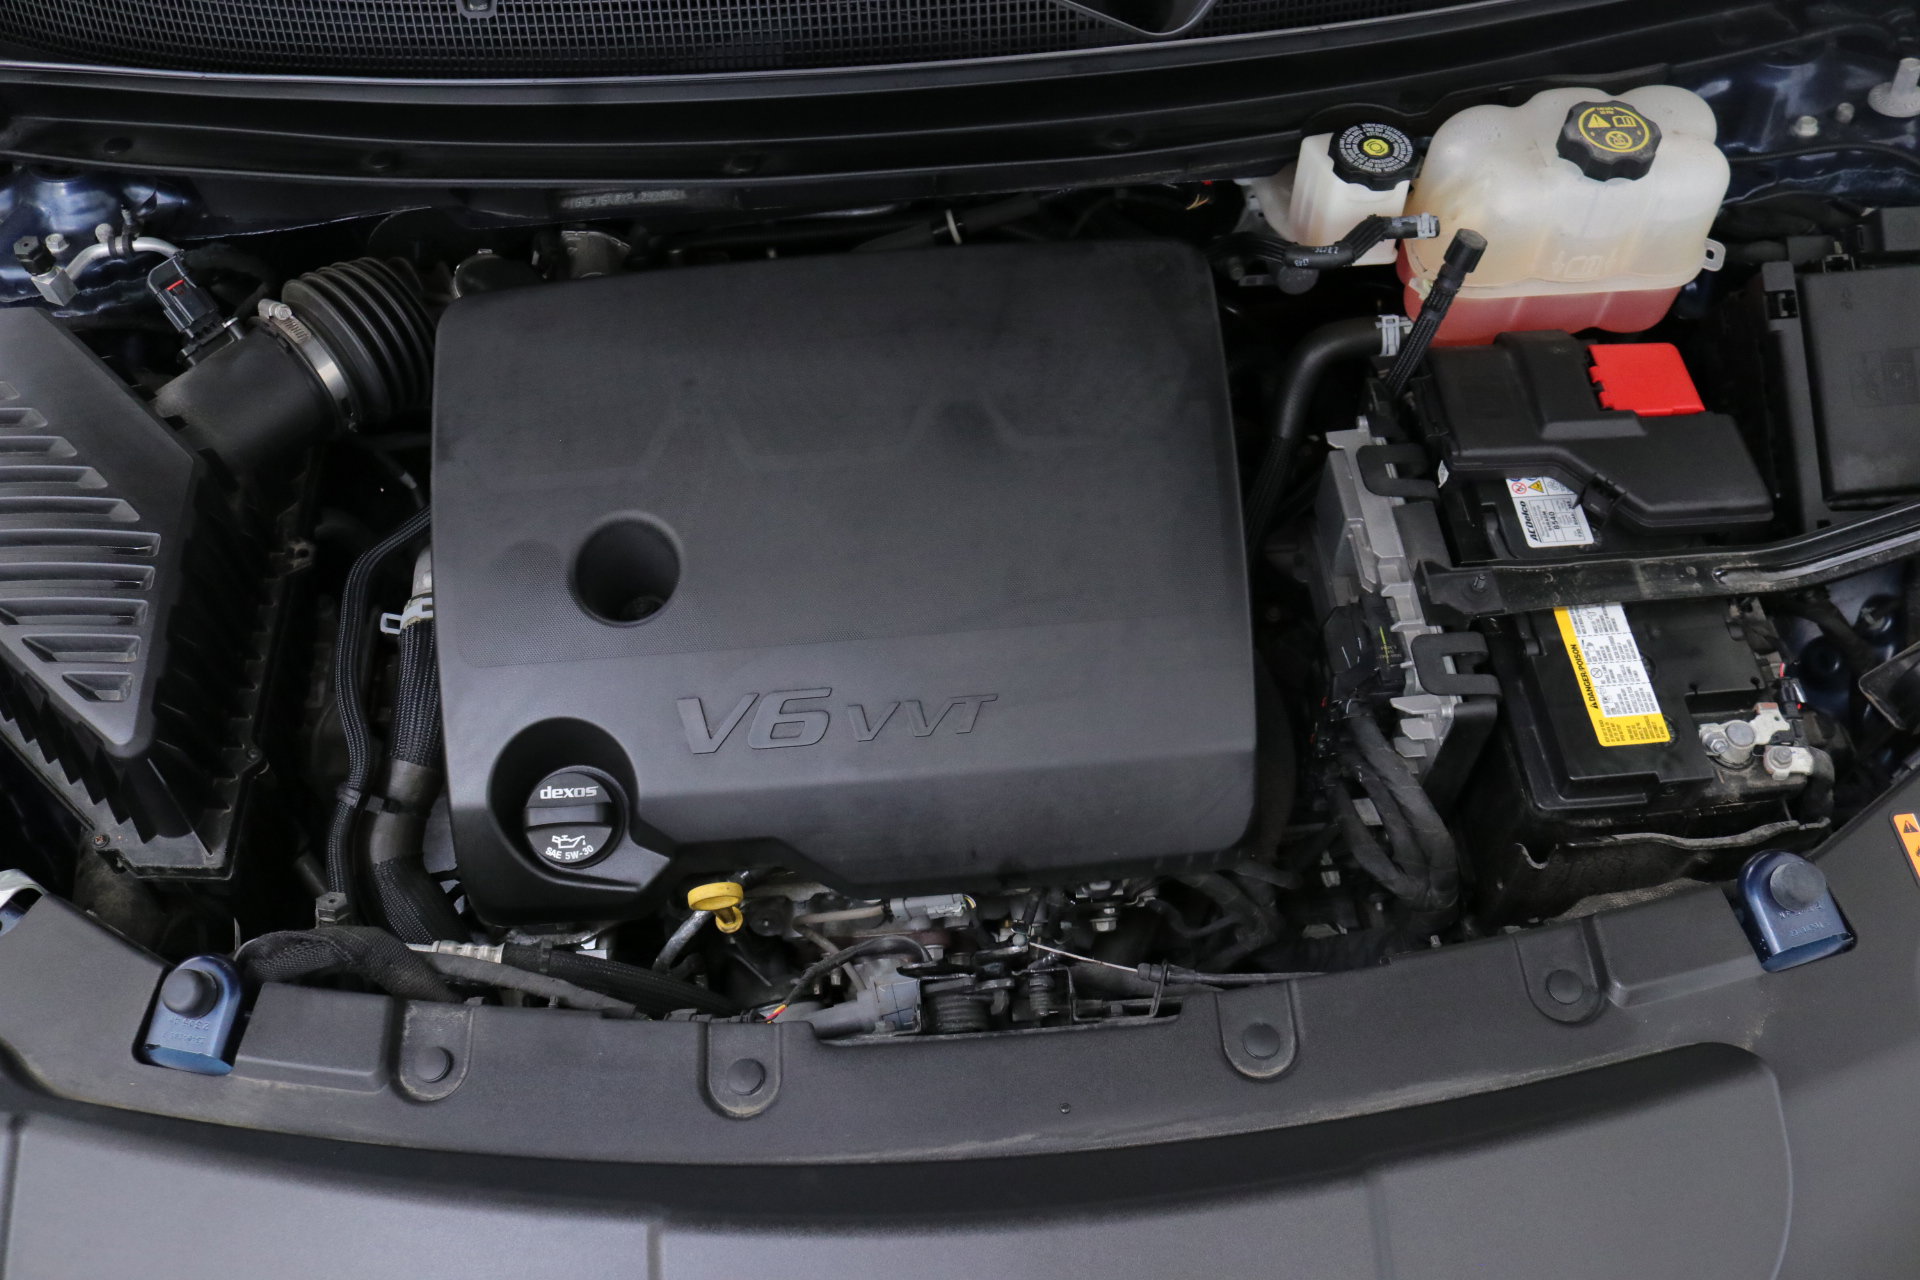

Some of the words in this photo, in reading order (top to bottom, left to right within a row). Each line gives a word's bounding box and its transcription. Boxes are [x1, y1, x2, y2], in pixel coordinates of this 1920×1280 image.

[1519, 500, 1539, 542] ACDelco
[676, 687, 833, 755] V6
[847, 693, 999, 742] VVT
[540, 785, 599, 799] dexos
[545, 846, 562, 860] SAE
[564, 845, 594, 860] 5W-30
